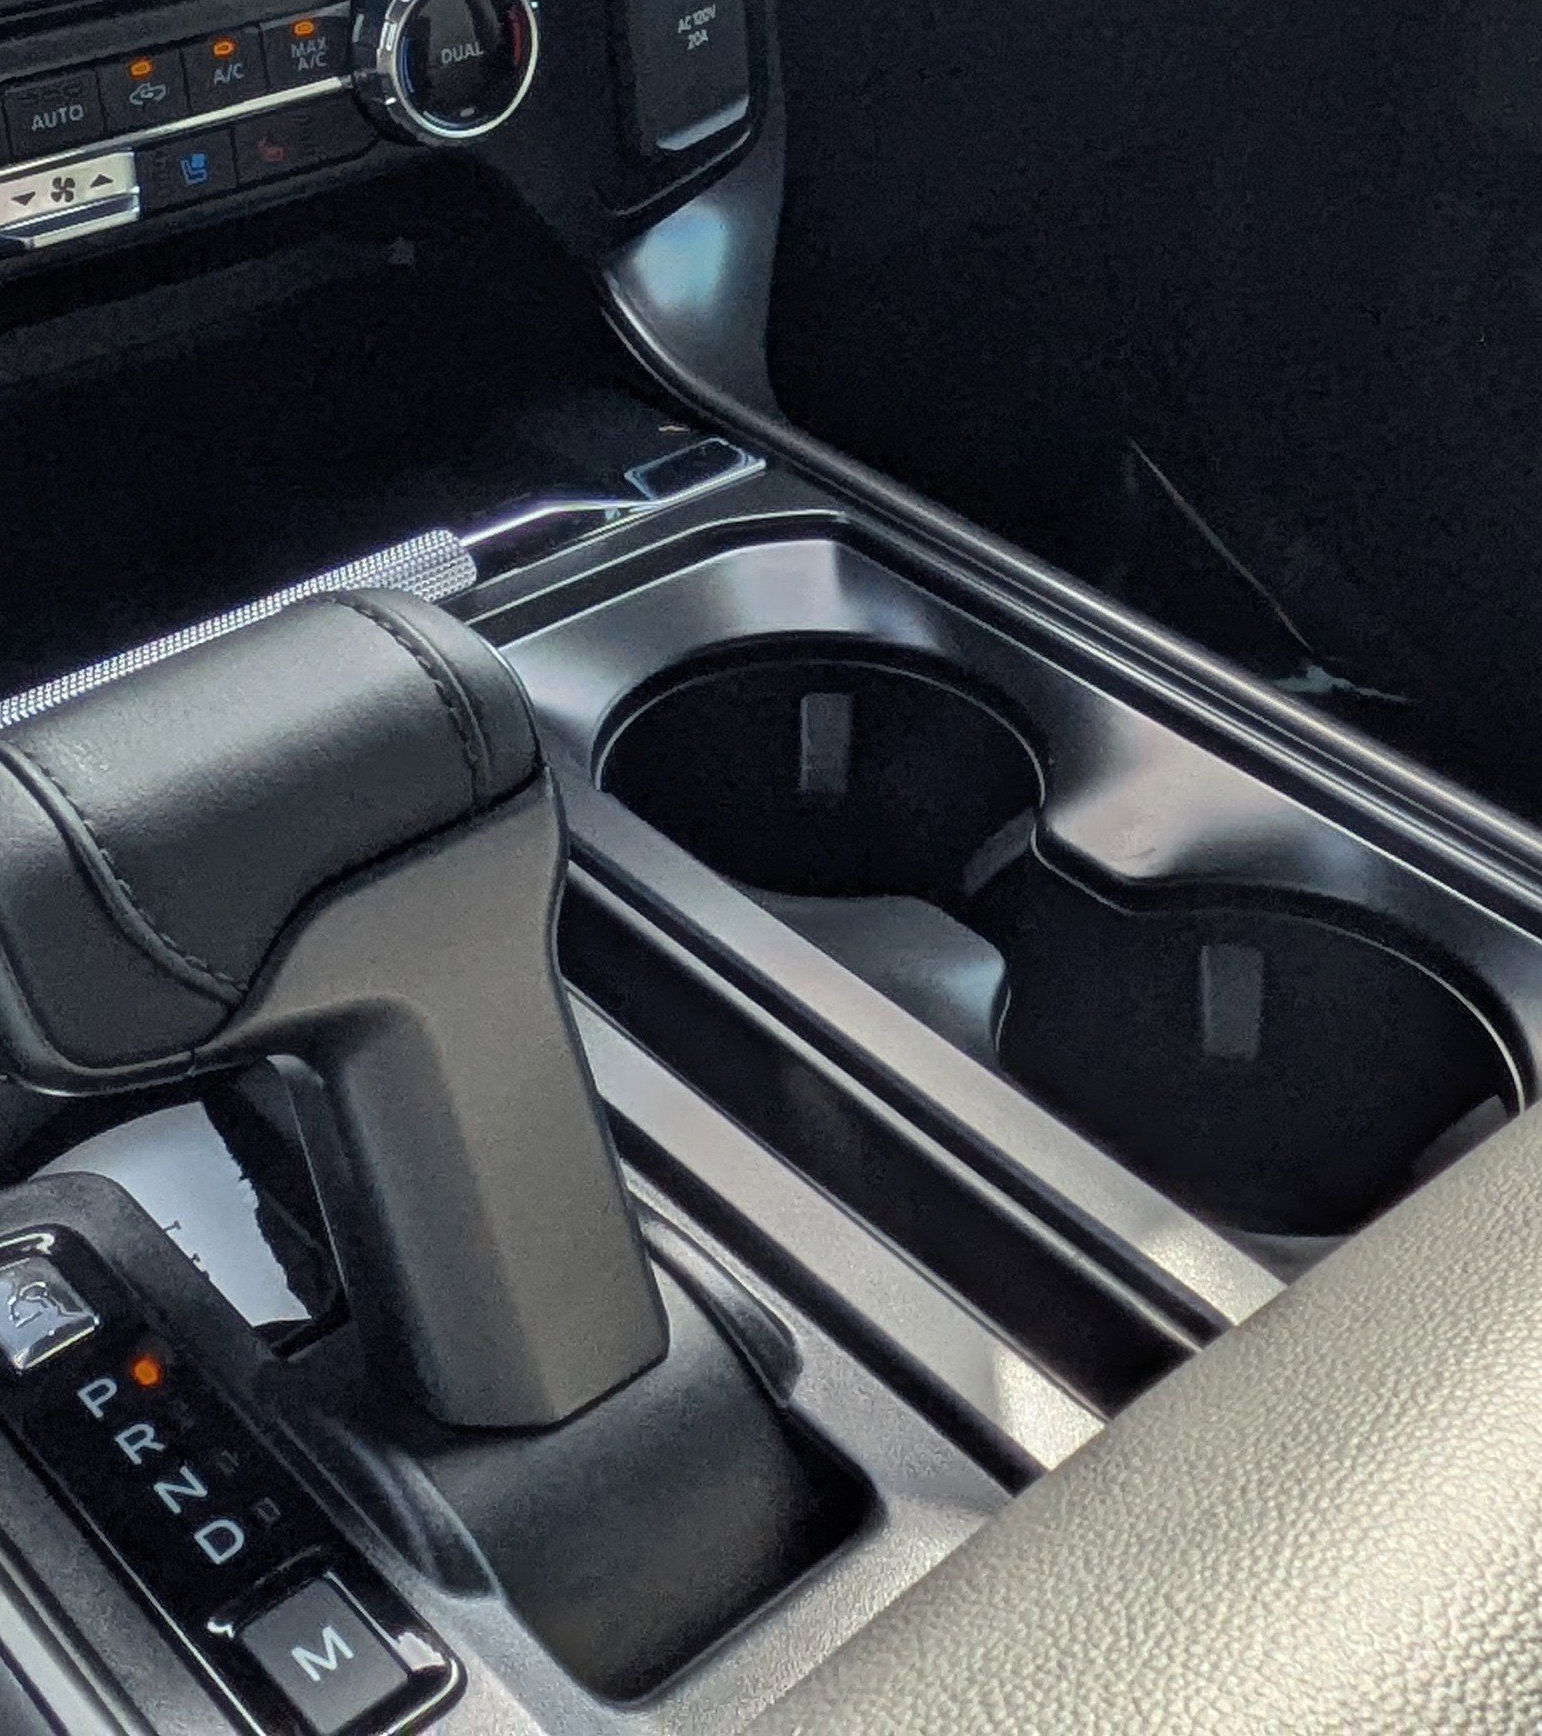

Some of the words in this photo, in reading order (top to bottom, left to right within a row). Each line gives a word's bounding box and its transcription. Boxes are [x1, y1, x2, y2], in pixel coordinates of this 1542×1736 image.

[290, 38, 328, 59] MAX
[440, 42, 484, 65] DUAL
[687, 30, 710, 51] 20A
[212, 63, 246, 86] A/C
[296, 52, 328, 72] A/C
[30, 103, 85, 132] AUTO
[76, 1377, 118, 1419] P
[114, 1422, 167, 1464] R
[153, 1466, 208, 1514] N
[193, 1518, 246, 1564] D
[290, 1625, 354, 1682] M
